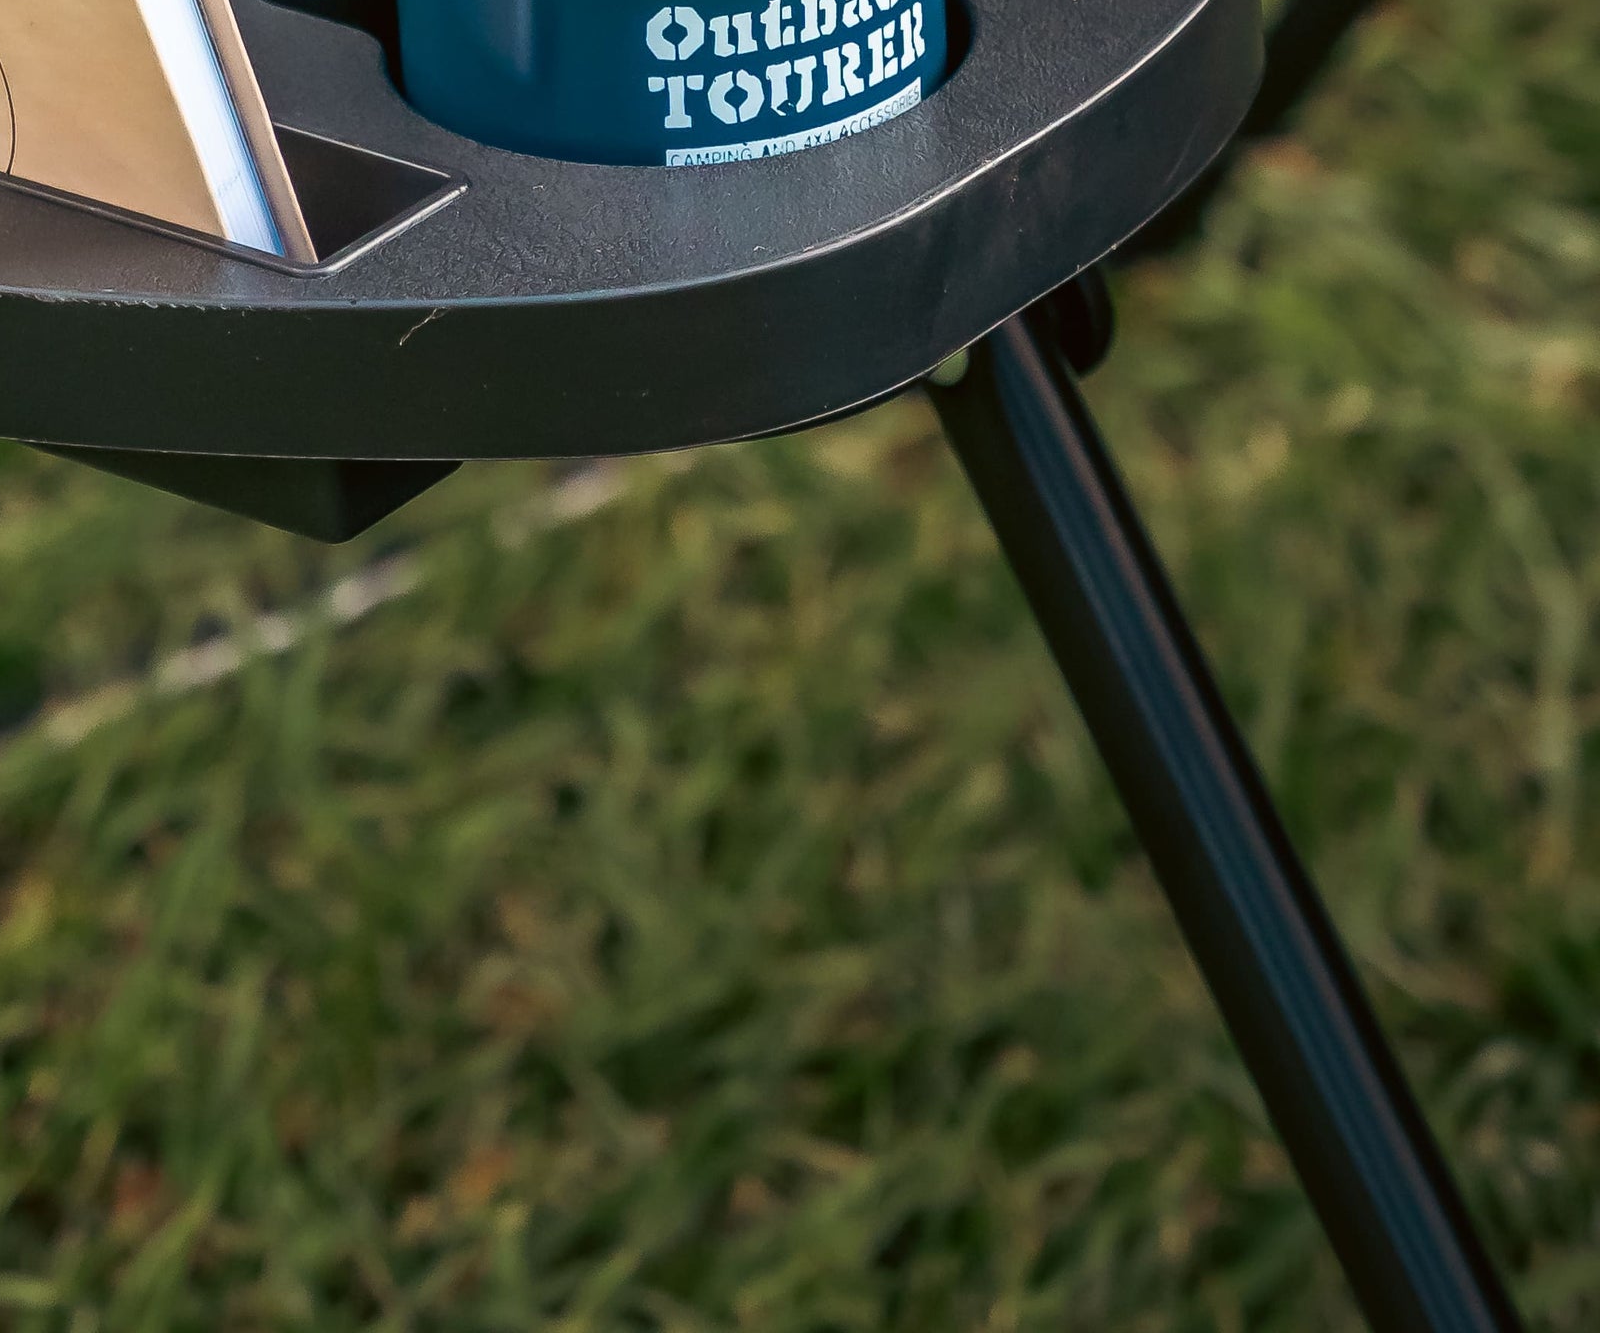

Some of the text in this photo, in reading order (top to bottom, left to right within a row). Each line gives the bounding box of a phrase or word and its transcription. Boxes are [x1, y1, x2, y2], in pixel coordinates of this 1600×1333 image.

[647, 1, 927, 129] TOURER
[669, 146, 753, 166] CAMPING
[762, 139, 796, 157] AND
[838, 83, 921, 139] ACCESSORIES
